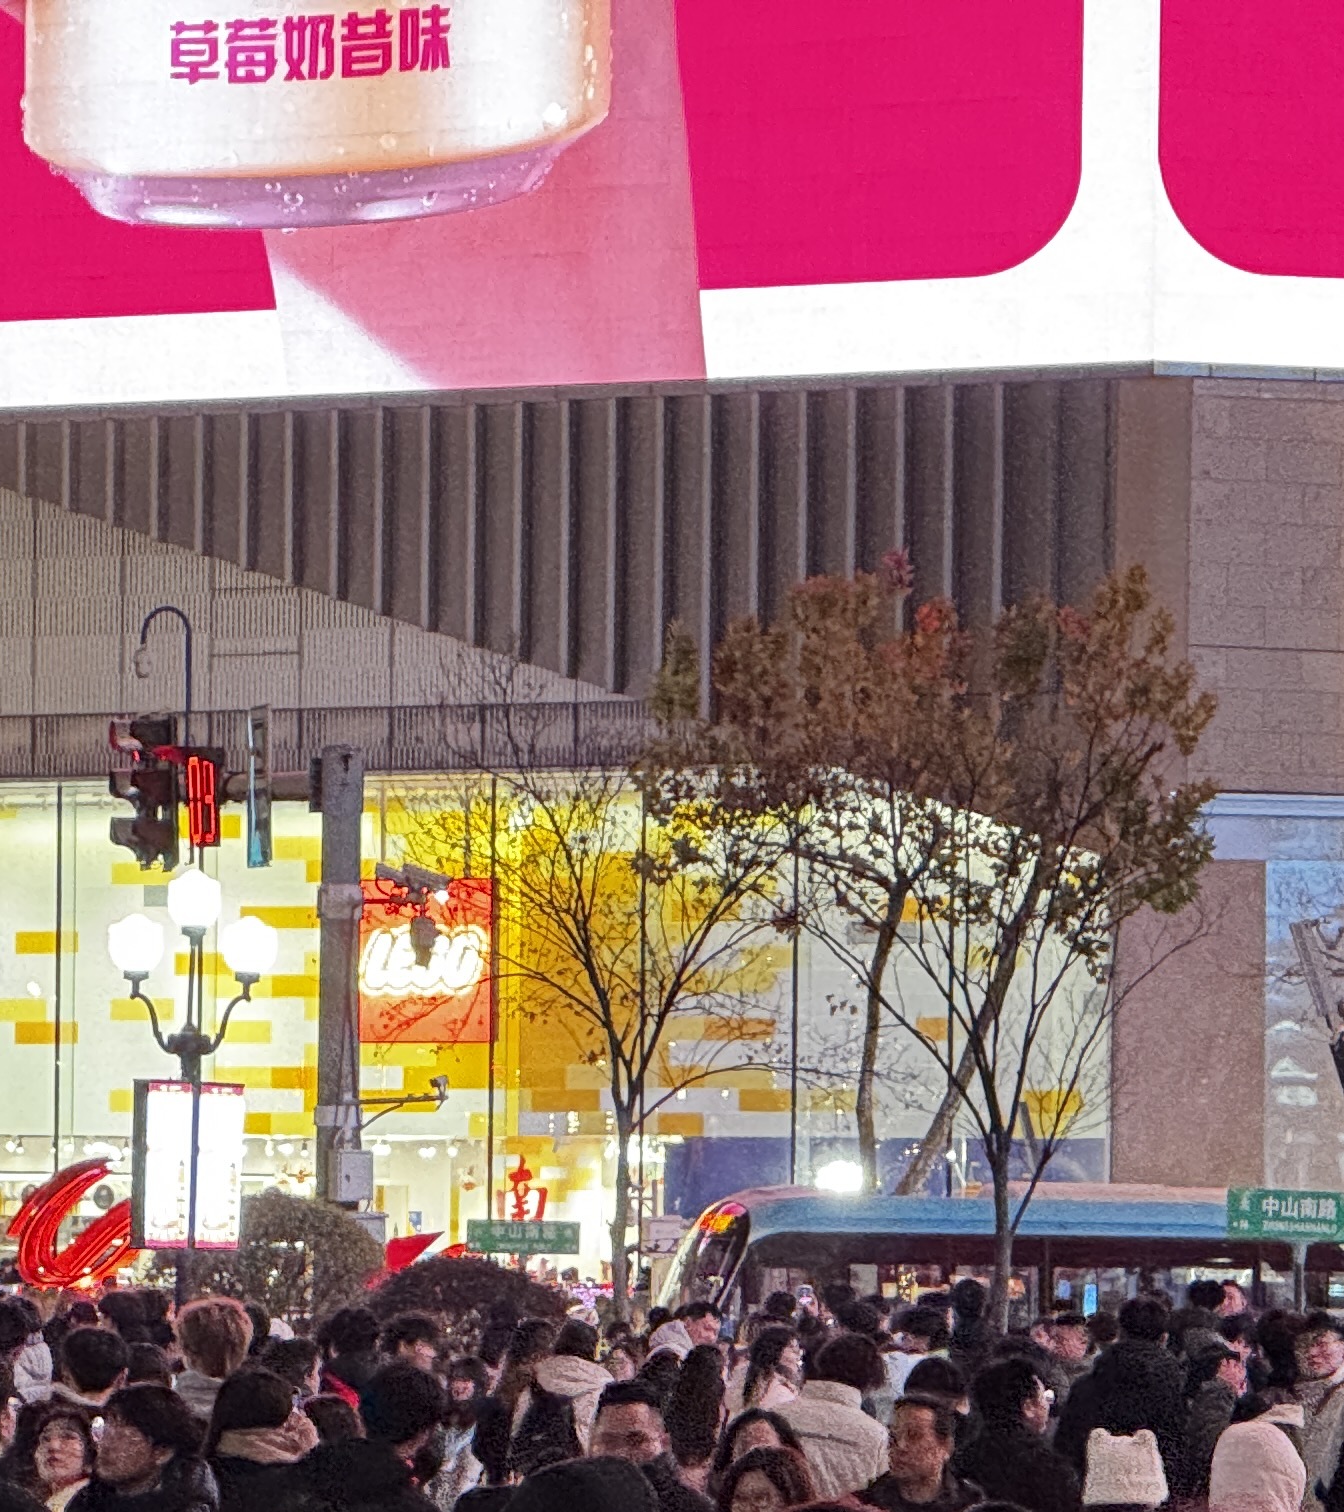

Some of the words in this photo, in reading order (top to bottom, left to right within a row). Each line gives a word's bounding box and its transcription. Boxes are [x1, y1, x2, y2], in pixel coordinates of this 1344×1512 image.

[170, 4, 451, 85] 草莓奶昔味
[1262, 1195, 1337, 1220] 中山南路
